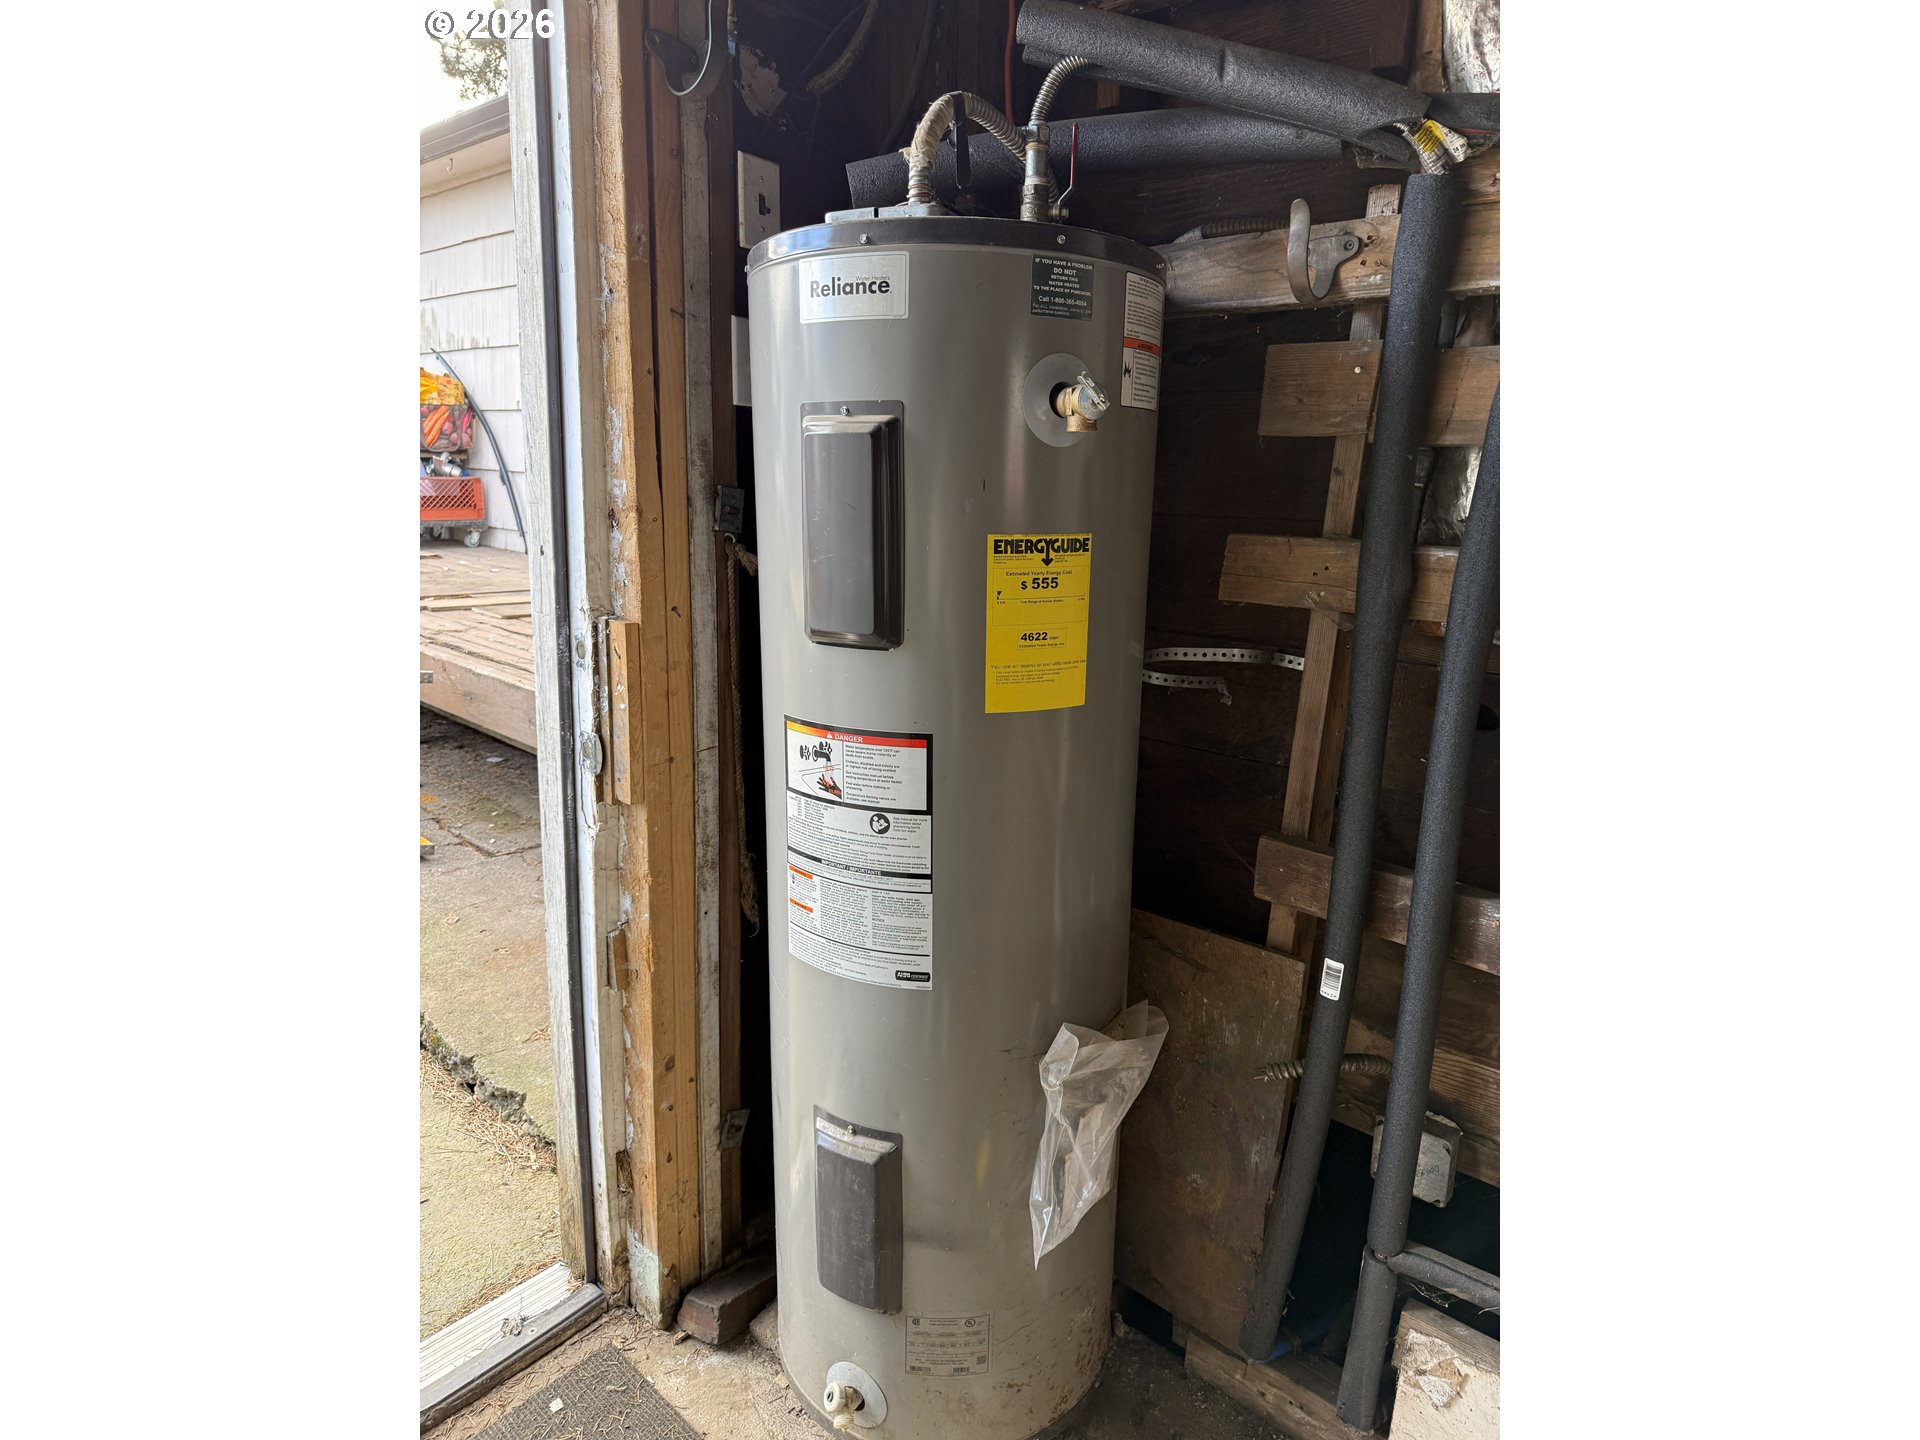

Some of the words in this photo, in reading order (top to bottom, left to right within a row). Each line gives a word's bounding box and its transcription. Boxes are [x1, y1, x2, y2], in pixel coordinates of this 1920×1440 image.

[1050, 296, 1087, 306] 1-800-365-4054
[994, 538, 1090, 556] ENERGYGUIDE
[1020, 580, 1028, 590] $
[1032, 576, 1058, 590] 555
[1020, 632, 1048, 642] 4622
[834, 734, 864, 743] DANGER
[822, 860, 846, 870] IMPORTANT
